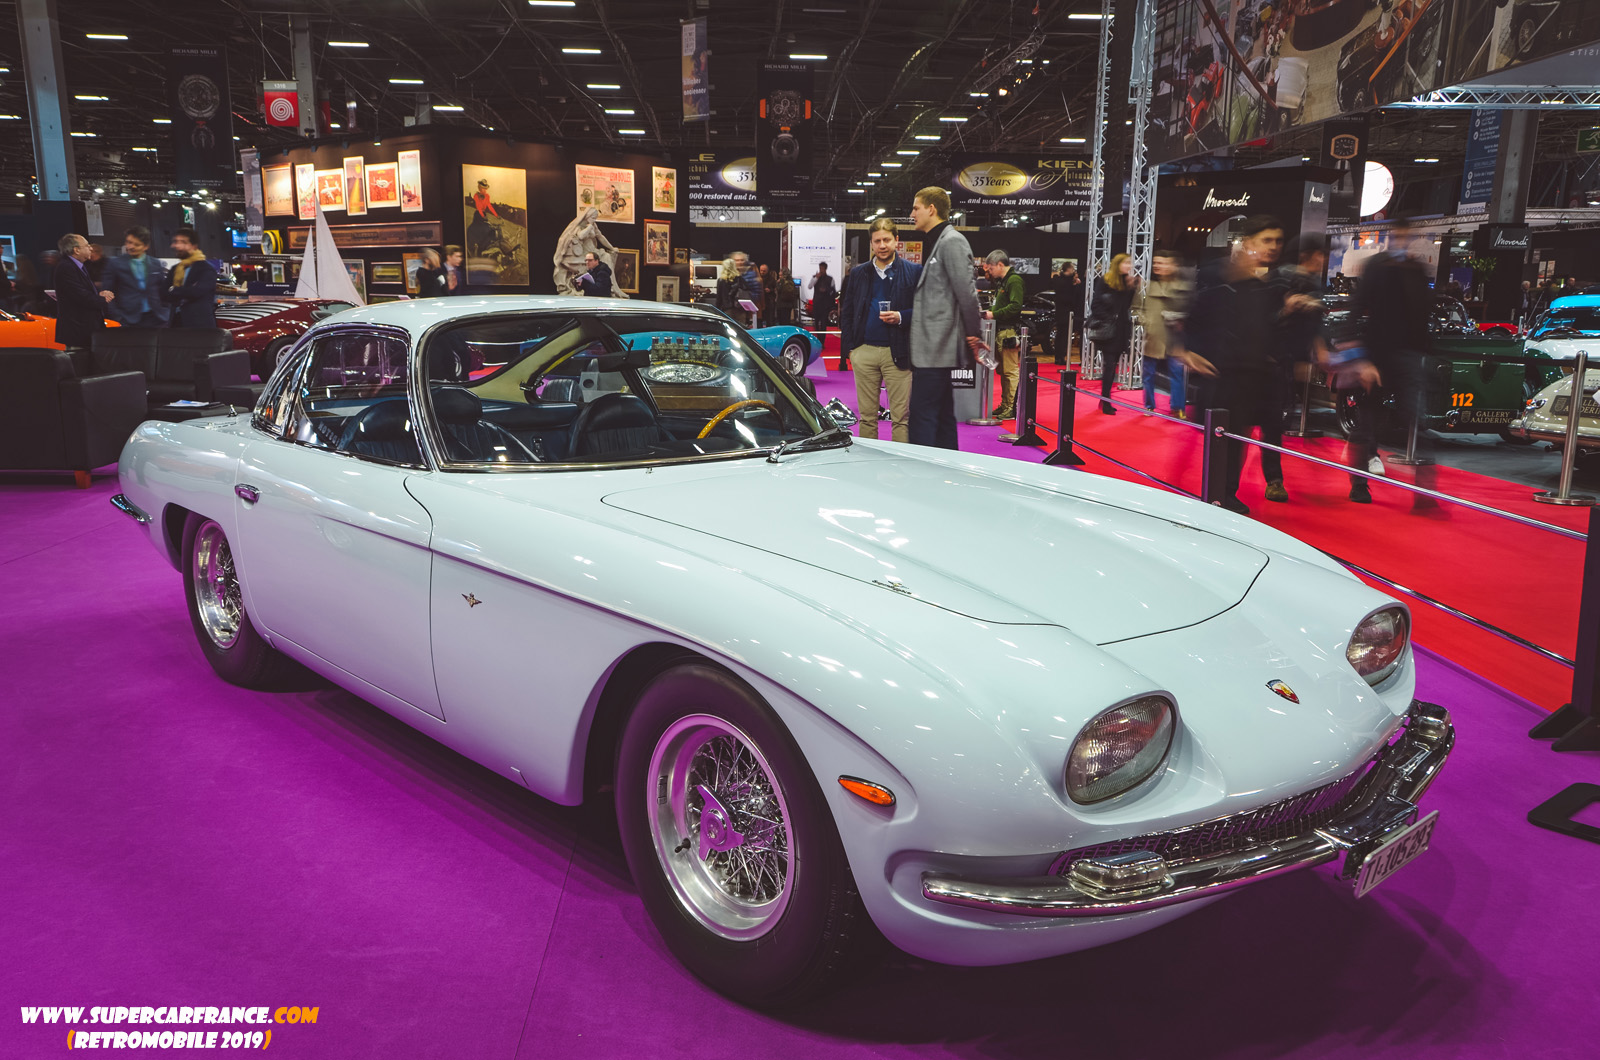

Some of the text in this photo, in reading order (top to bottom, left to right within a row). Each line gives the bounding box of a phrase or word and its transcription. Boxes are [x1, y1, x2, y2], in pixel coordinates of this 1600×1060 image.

[1038, 160, 1094, 169] KIEN
[689, 165, 708, 173] chnik
[1018, 198, 1035, 206] 1000
[1036, 198, 1064, 206] restored
[1065, 198, 1080, 206] and
[1081, 198, 1093, 206] tra
[1451, 393, 1474, 407] 112
